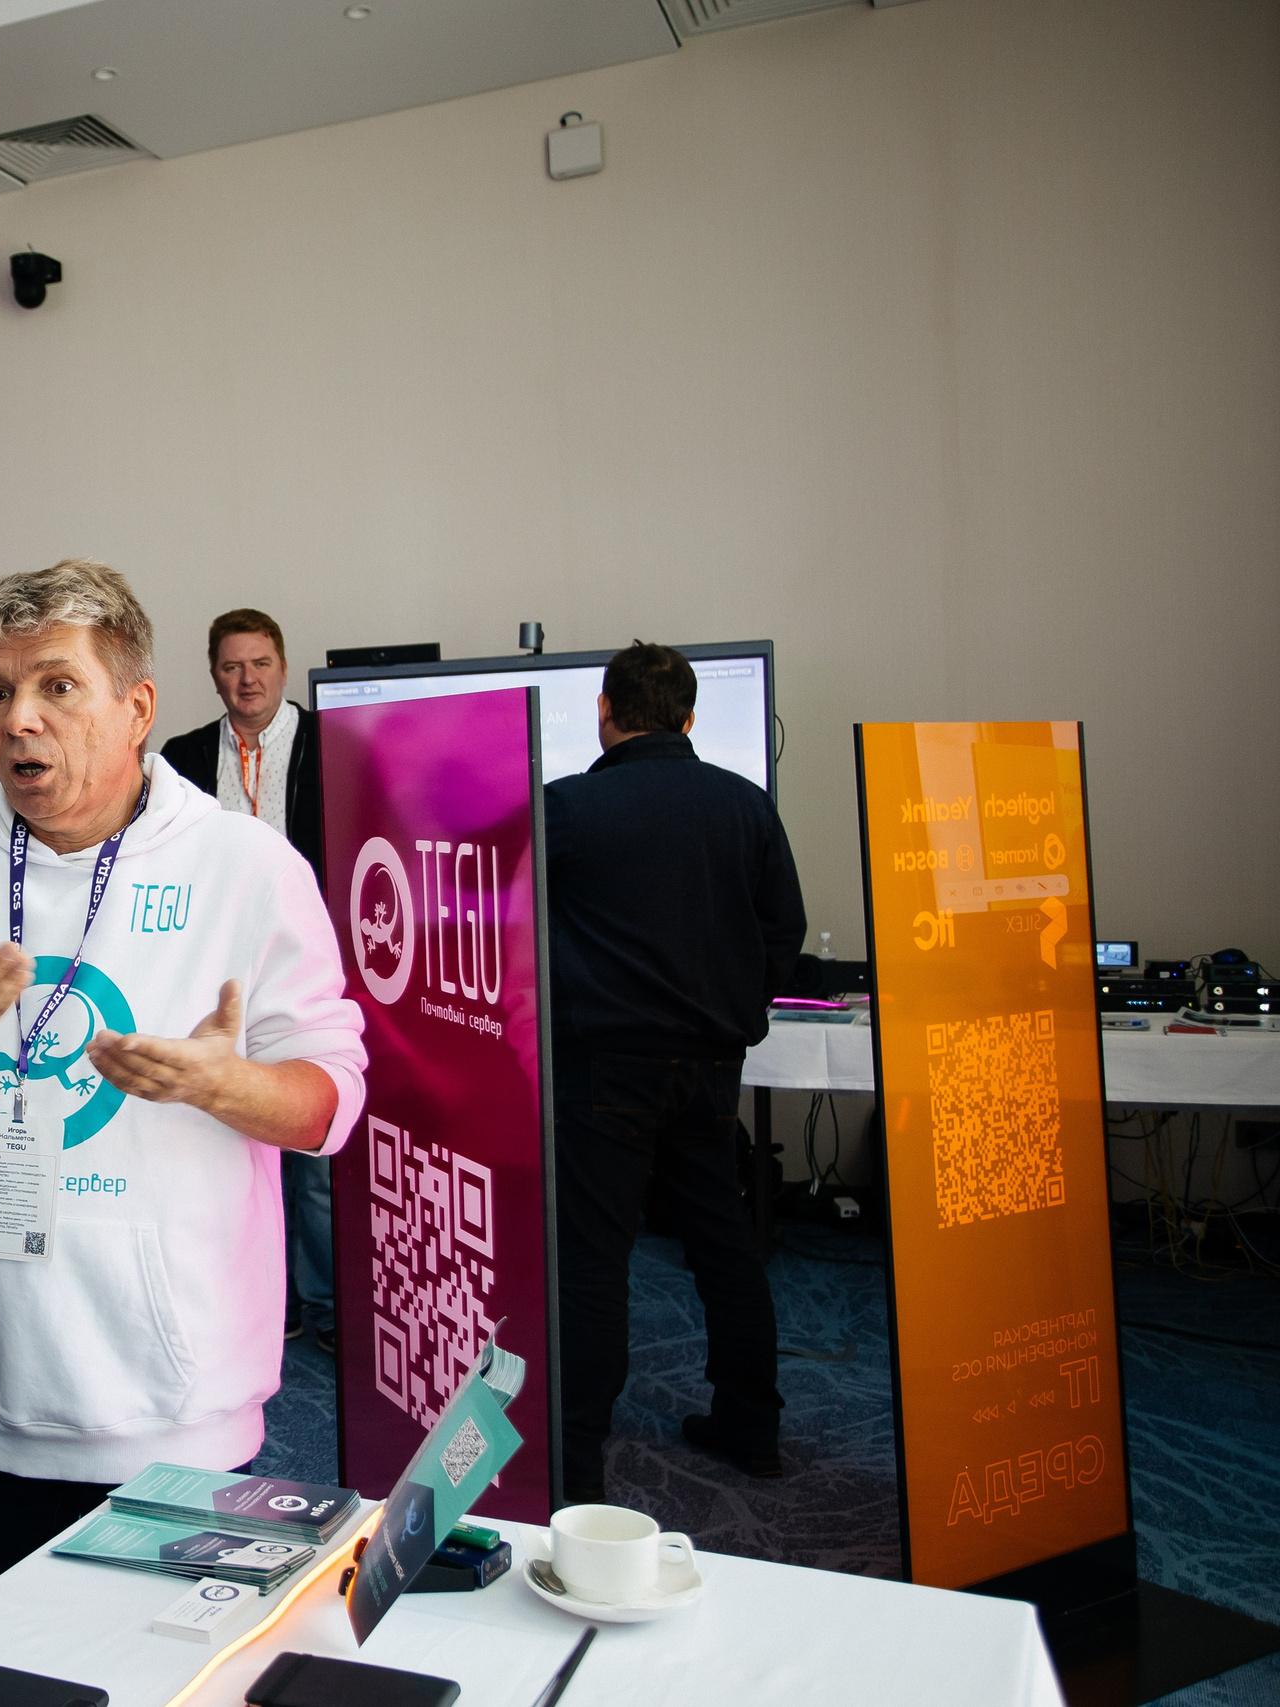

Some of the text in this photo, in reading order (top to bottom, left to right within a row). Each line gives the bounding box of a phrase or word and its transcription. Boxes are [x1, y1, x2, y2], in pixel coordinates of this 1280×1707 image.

[13, 881, 21, 911] OCS
[131, 883, 192, 934] TEGU
[415, 838, 502, 1005] TEGU
[421, 996, 502, 1041] Почтовый сервер
[6, 1142, 27, 1151] TEGU
[7, 1126, 28, 1136] Игорь
